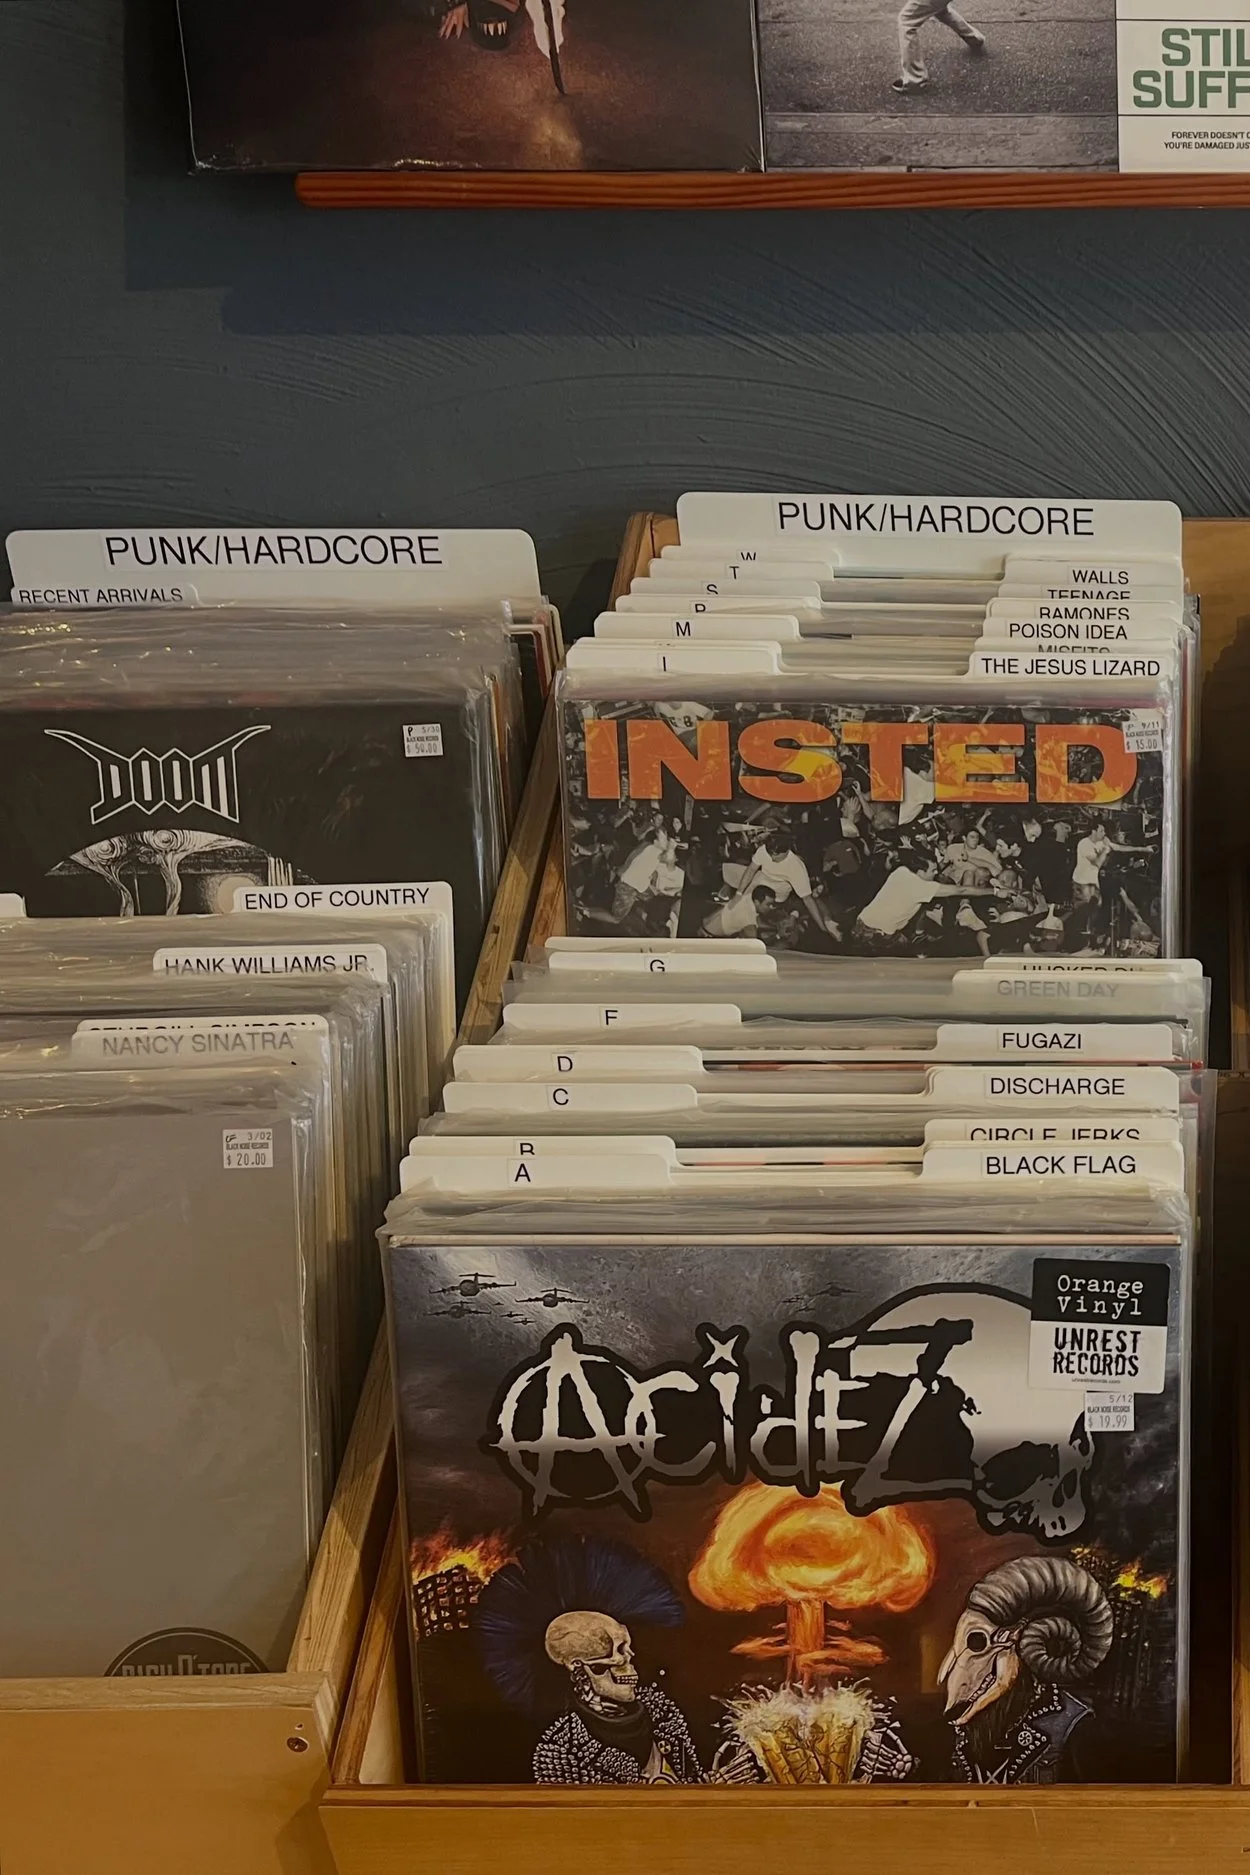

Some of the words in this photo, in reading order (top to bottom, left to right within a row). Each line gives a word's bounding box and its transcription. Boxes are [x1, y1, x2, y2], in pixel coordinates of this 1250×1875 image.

[1171, 131, 1209, 139] FOREVER
[1210, 131, 1245, 139] DOESN'T
[778, 501, 1095, 536] PUNK/HARDCORE
[105, 535, 443, 566] PUNK/HARDCORE
[729, 566, 740, 580] T
[1072, 569, 1129, 585] WALLS
[19, 588, 90, 605] RECENT
[96, 587, 183, 604] ARRIVALS
[1039, 606, 1130, 621] RAMONES
[675, 621, 692, 637] M
[1009, 623, 1080, 640] POISON
[1085, 624, 1128, 640] IDEA
[981, 657, 1019, 675] THE
[1025, 658, 1087, 675] JESUS
[1092, 660, 1161, 676] LIZARD
[584, 718, 1138, 804] INSTED
[45, 725, 271, 824] DOOM
[245, 893, 288, 910] END
[294, 891, 323, 909] OF
[328, 887, 430, 908] COUNTRY
[165, 957, 228, 974] HANK
[232, 955, 337, 974] WILLIAMS
[649, 959, 666, 973] G
[997, 979, 1071, 997] GREEN
[1077, 981, 1120, 999] DAY
[605, 1009, 618, 1026] F
[103, 1032, 183, 1057] NANCY
[191, 1031, 295, 1053] SINATRA
[1002, 1032, 1083, 1050] FUGAZI
[557, 1055, 573, 1072] D
[990, 1077, 1125, 1096] DISCHARGE
[552, 1088, 570, 1106] C
[247, 1131, 272, 1141] 3/02
[970, 1127, 1057, 1141] CIRCLE
[1072, 1127, 1140, 1141] JERKS
[236, 1152, 266, 1166] 20.00
[985, 1155, 1066, 1176] BLACK
[1073, 1154, 1137, 1174] FLAG
[514, 1163, 532, 1183] A
[1057, 1274, 1144, 1299] Orange
[1057, 1296, 1142, 1320] Vinyl
[1054, 1327, 1142, 1354] UNREST
[1052, 1351, 1139, 1377] RECORDS
[1109, 1394, 1134, 1404] 5/12
[1100, 1415, 1128, 1429] 19.99
